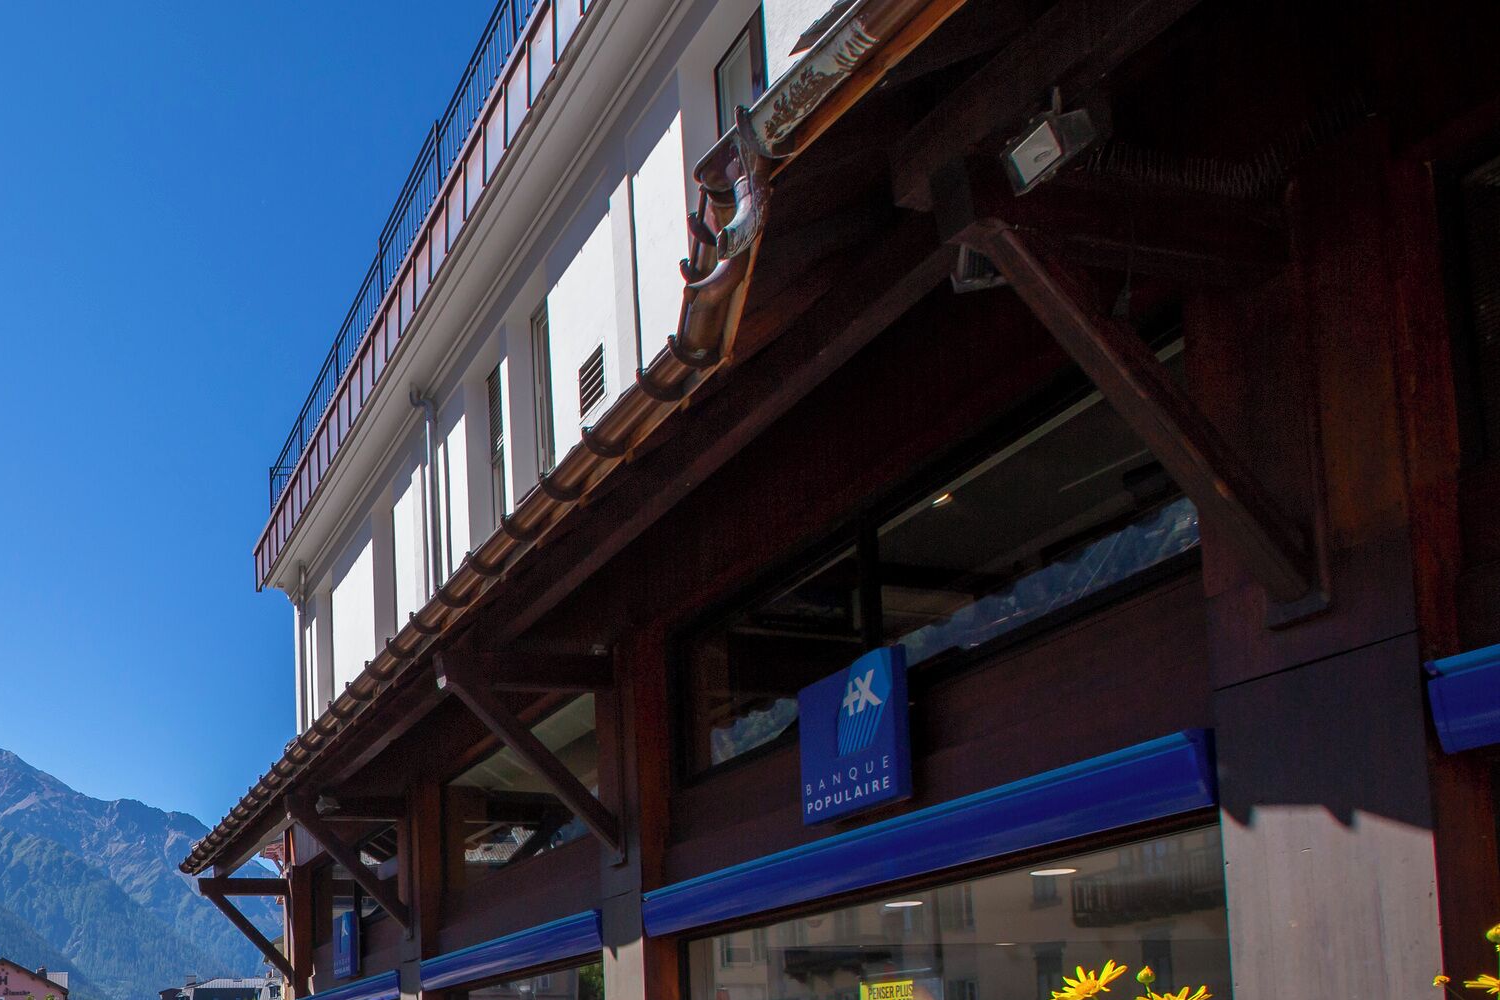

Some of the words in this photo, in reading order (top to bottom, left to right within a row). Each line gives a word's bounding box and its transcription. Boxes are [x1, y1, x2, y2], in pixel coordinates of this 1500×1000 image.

[806, 755, 889, 796] BANQUE
[807, 776, 890, 815] POPULAIRE
[868, 985, 895, 1000] PENSER
[895, 983, 913, 998] PLUS
